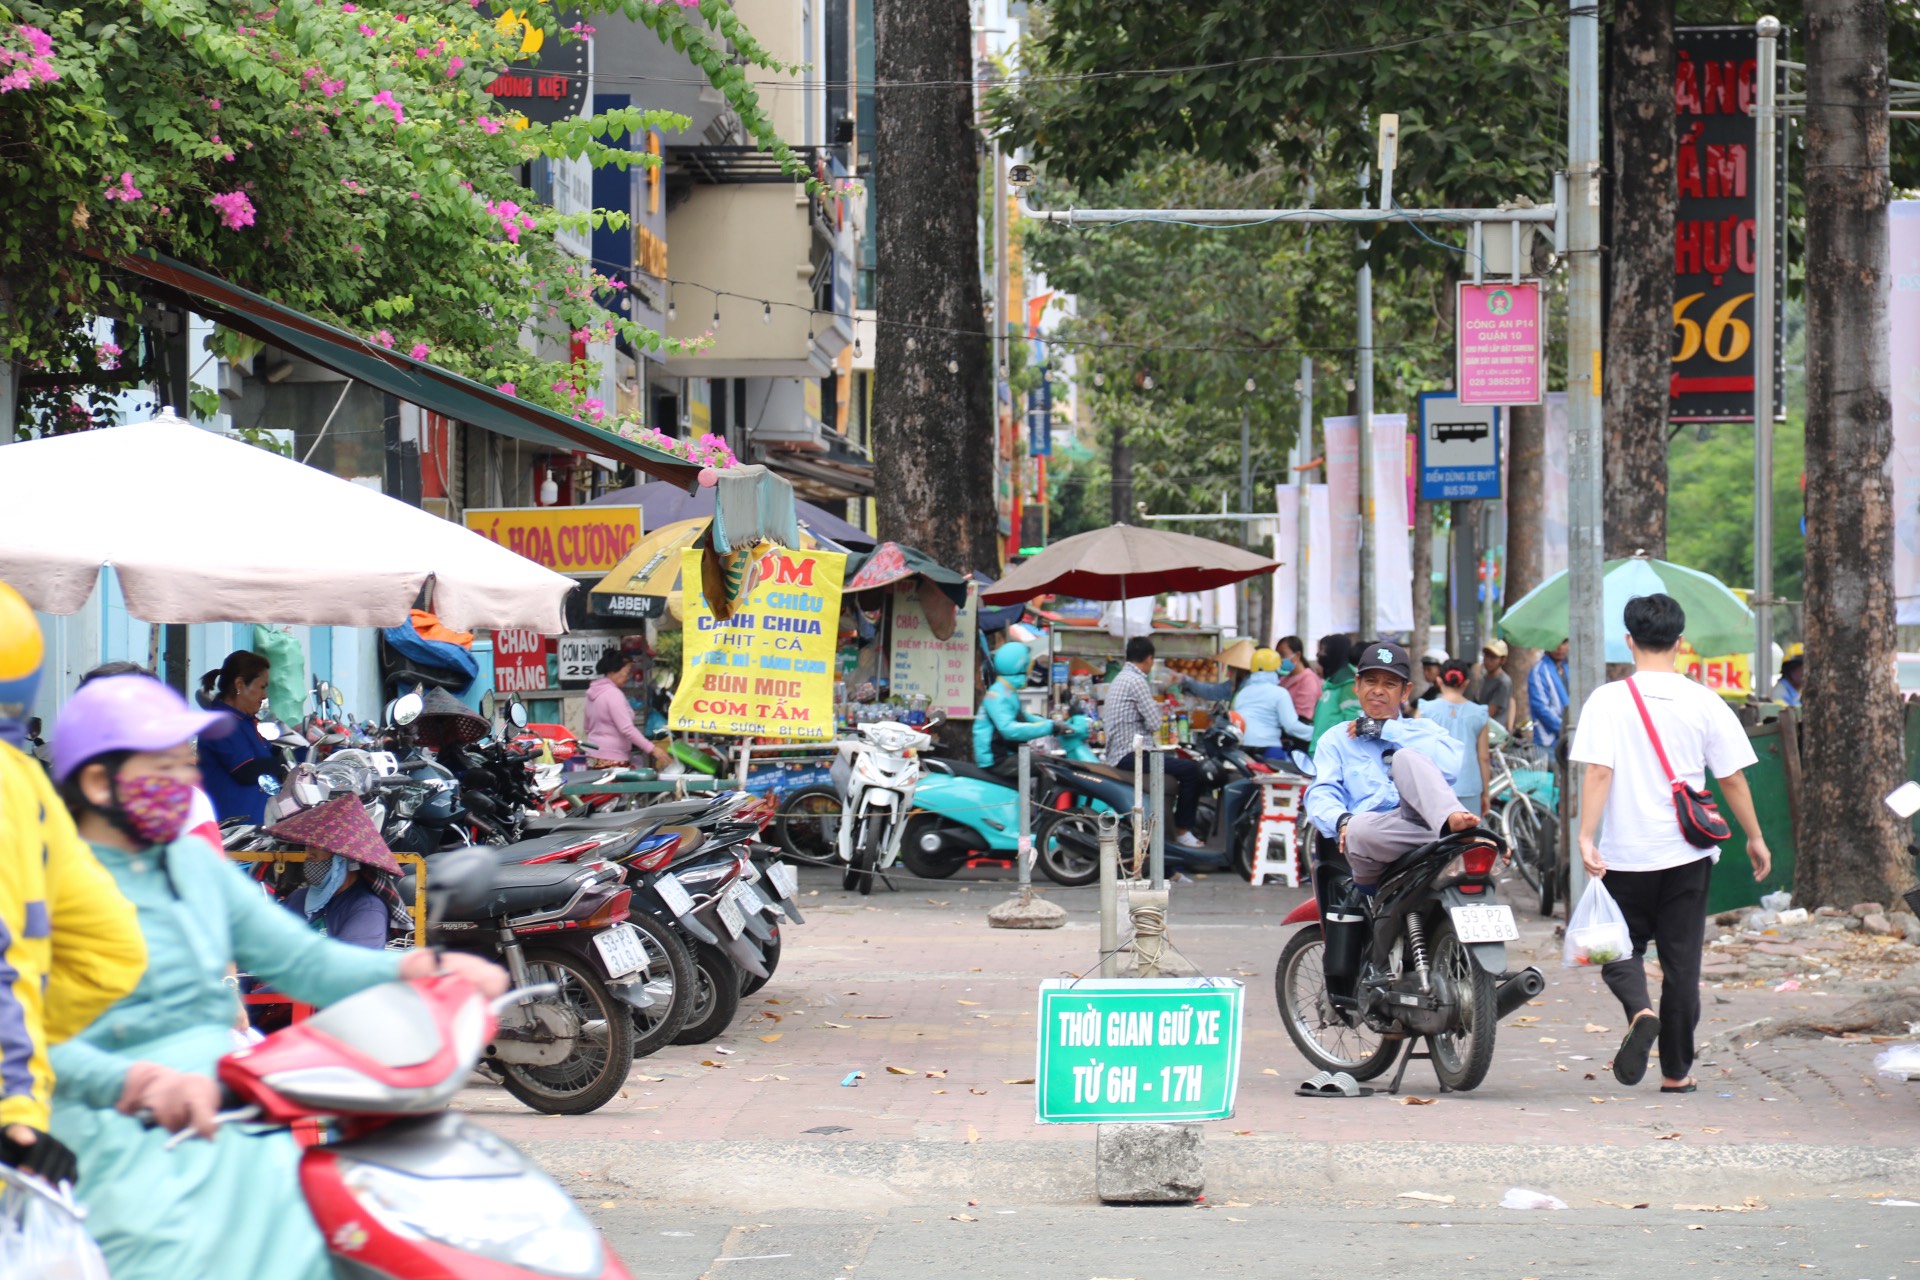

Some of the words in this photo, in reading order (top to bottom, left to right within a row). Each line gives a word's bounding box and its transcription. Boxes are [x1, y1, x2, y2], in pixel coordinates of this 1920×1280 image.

[1675, 49, 1758, 115] ÀNG
[1675, 213, 1757, 287] HỰC
[1466, 318, 1496, 329] CÔNG
[1499, 320, 1513, 328] AN
[1516, 319, 1534, 328] P14
[1478, 331, 1507, 342] QUẬN
[1511, 332, 1522, 340] 10
[1467, 471, 1477, 481] XE
[1443, 485, 1459, 496] BUS
[1459, 485, 1479, 495] STOP
[508, 526, 556, 567] HOA
[558, 522, 636, 567] CƯƠNG
[608, 596, 651, 611] ABBEN
[762, 615, 822, 635] CHUA
[561, 641, 579, 662] CƠM
[713, 633, 756, 649] THỊT
[774, 636, 803, 651] CÁ
[496, 655, 547, 691] TRẮNG
[703, 672, 748, 693] BÚN
[944, 674, 964, 683] HEO
[693, 698, 748, 717] CƠM
[756, 698, 810, 720] TẤM
[1058, 1003, 1102, 1047] THỜI
[1106, 1011, 1153, 1047] GIAN
[1158, 1004, 1193, 1046] GIỮ
[1195, 1010, 1220, 1046] XE
[1072, 1058, 1104, 1103] TỪ
[1106, 1066, 1137, 1103] 6H
[1143, 1082, 1152, 1091] -
[1160, 1065, 1203, 1102] 17H
